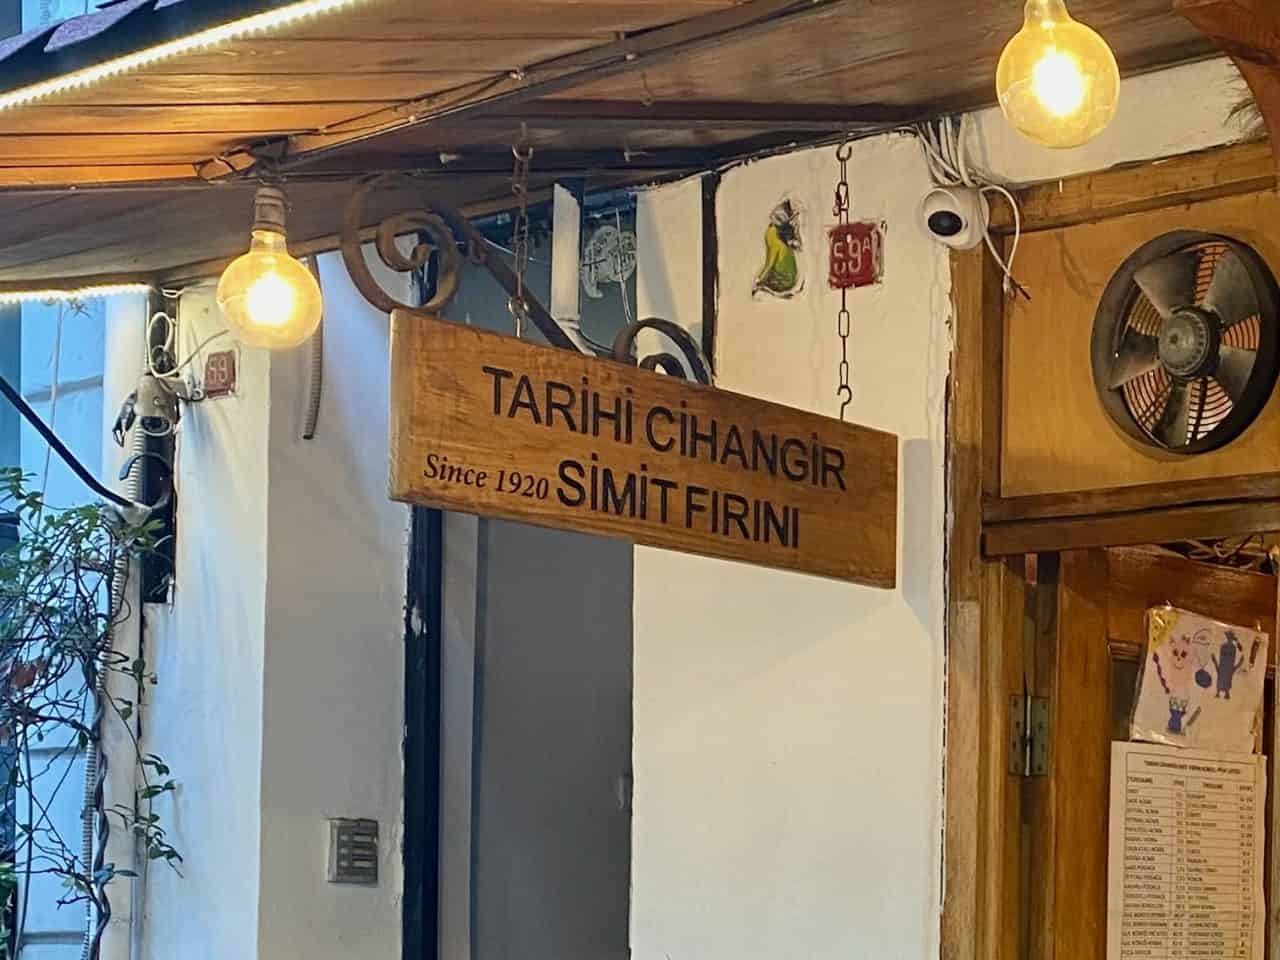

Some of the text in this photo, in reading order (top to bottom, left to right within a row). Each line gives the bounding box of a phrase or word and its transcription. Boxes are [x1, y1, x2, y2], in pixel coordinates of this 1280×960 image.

[423, 452, 549, 500] Since 1920
[482, 365, 848, 492] TARİHİ CİHANGİR
[556, 452, 799, 549] SİMİT FIRINI
